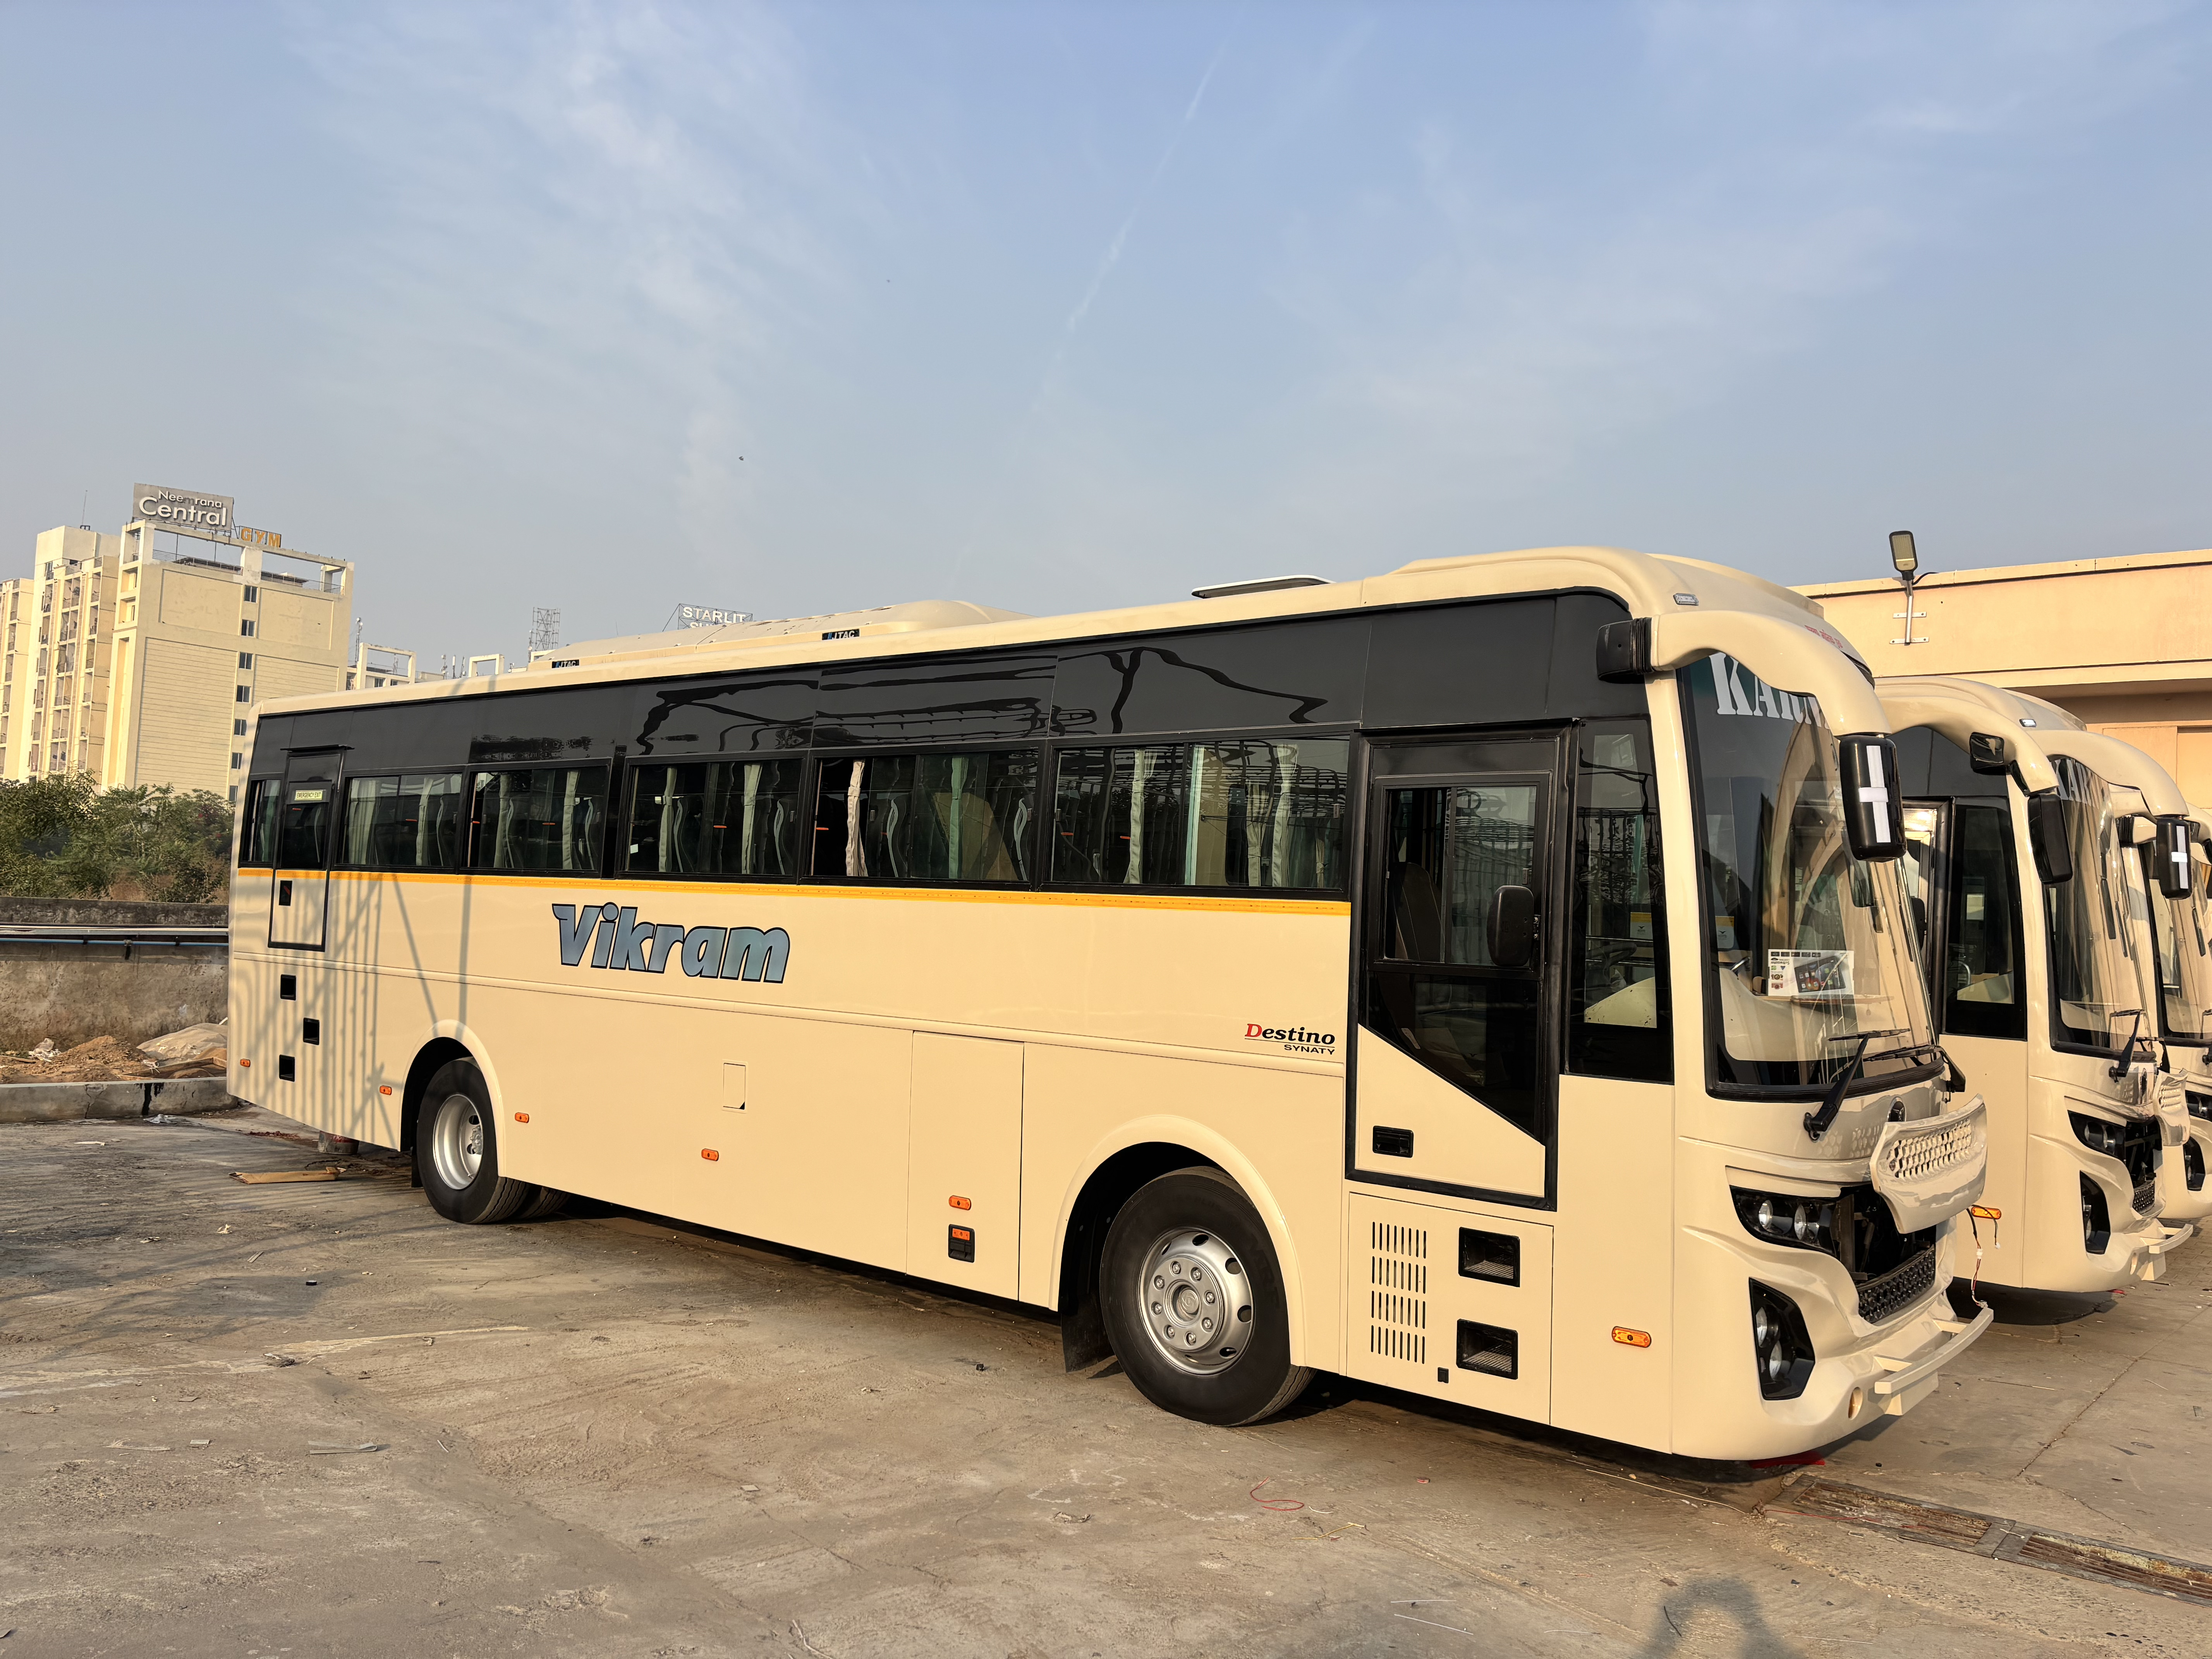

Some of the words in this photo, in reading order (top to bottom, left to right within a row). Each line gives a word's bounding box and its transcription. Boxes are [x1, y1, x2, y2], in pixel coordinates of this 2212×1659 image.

[139, 496, 227, 526] Central
[241, 527, 281, 548] GYM
[682, 606, 746, 623] STARLIT
[551, 902, 790, 984] Vikram
[1244, 1023, 1335, 1045] Destino
[1284, 1044, 1335, 1055] SYNATY
